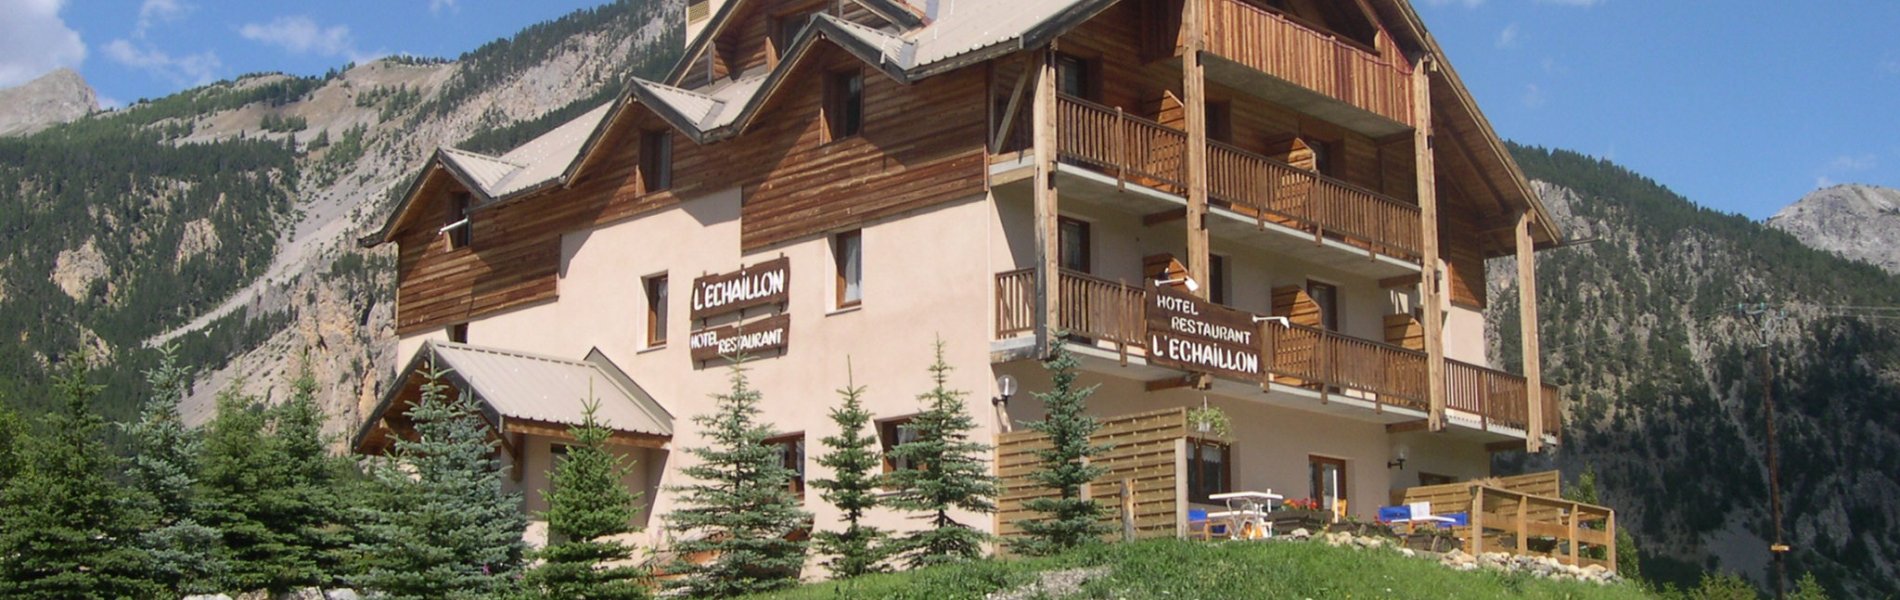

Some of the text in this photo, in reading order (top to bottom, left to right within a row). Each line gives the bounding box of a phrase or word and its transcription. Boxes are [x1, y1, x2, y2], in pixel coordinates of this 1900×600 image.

[1156, 294, 1199, 315] HOTEL
[690, 330, 719, 349] HOTEL
[1171, 316, 1251, 344] RESTAURANT
